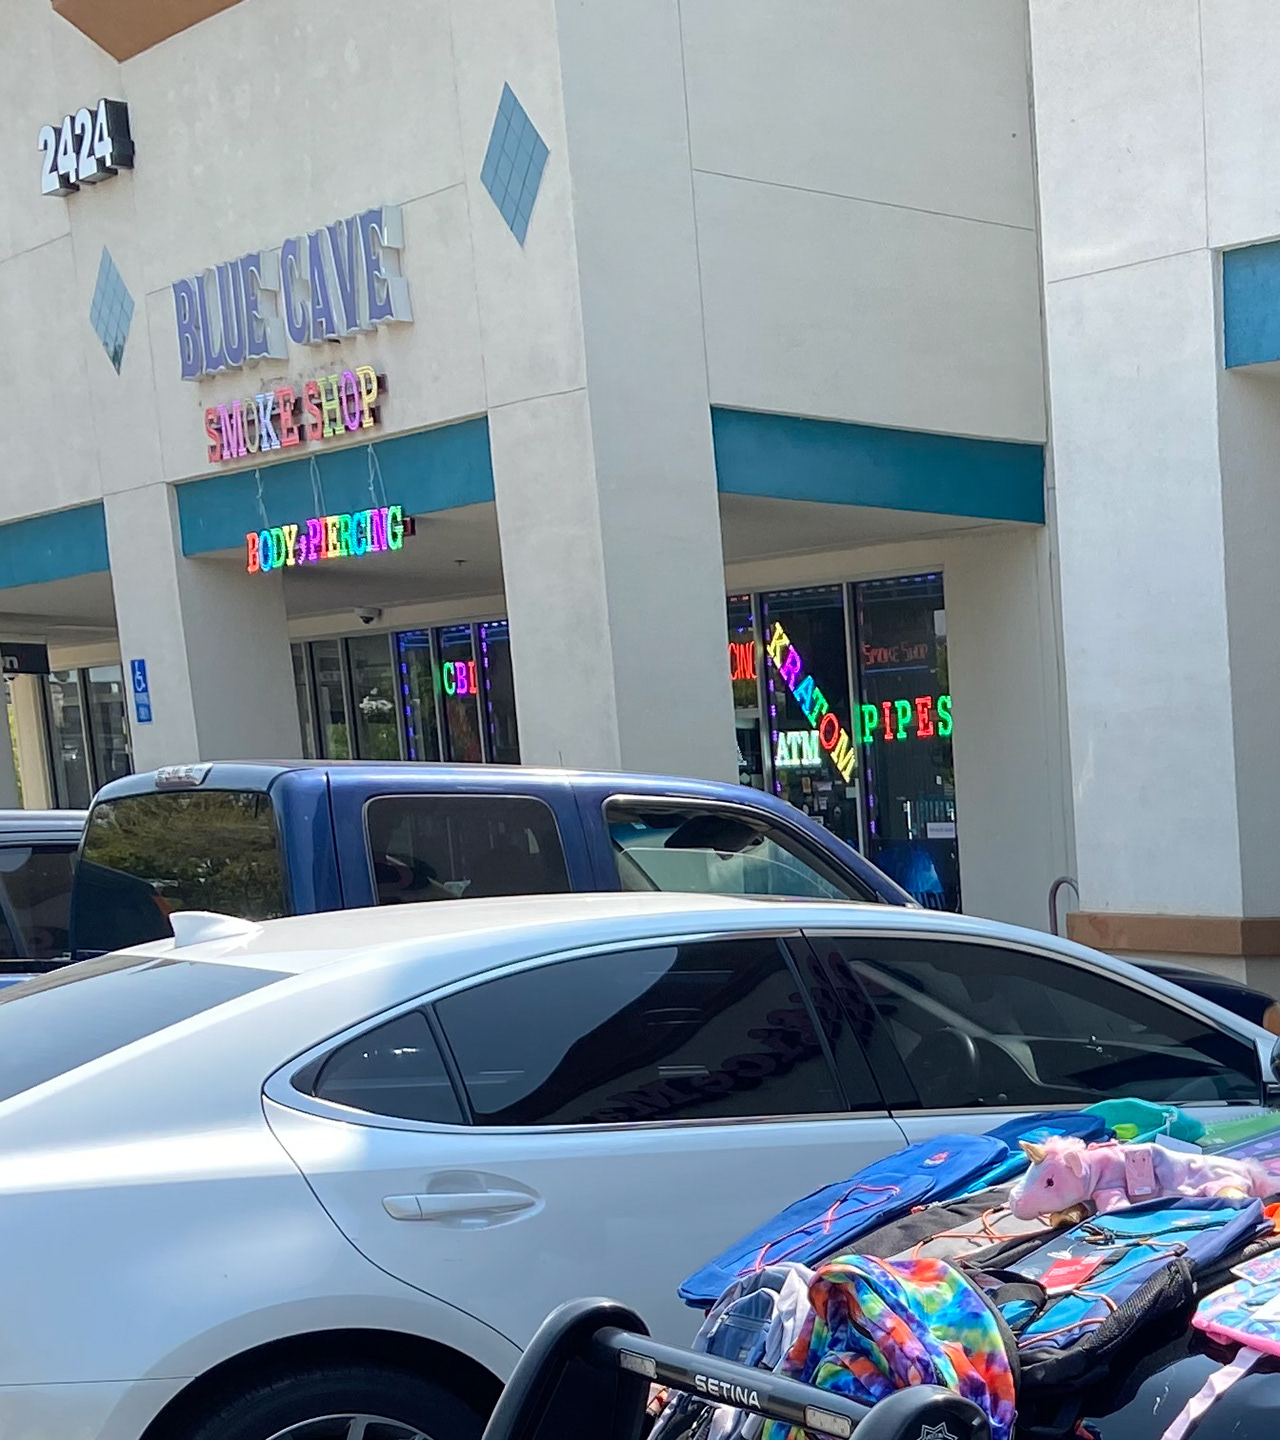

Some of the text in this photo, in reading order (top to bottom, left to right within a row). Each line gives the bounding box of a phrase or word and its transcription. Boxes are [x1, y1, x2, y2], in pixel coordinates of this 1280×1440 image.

[38, 99, 113, 195] 2424
[171, 205, 413, 380] BLUE CAVE
[205, 366, 379, 462] SMOKE SHOP
[246, 524, 298, 574] BODY
[306, 506, 404, 561] PIERCING
[767, 622, 856, 783] KRATOM
[861, 695, 953, 743] PIPES
[775, 730, 821, 767] ATM
[694, 1374, 761, 1409] SETINA
